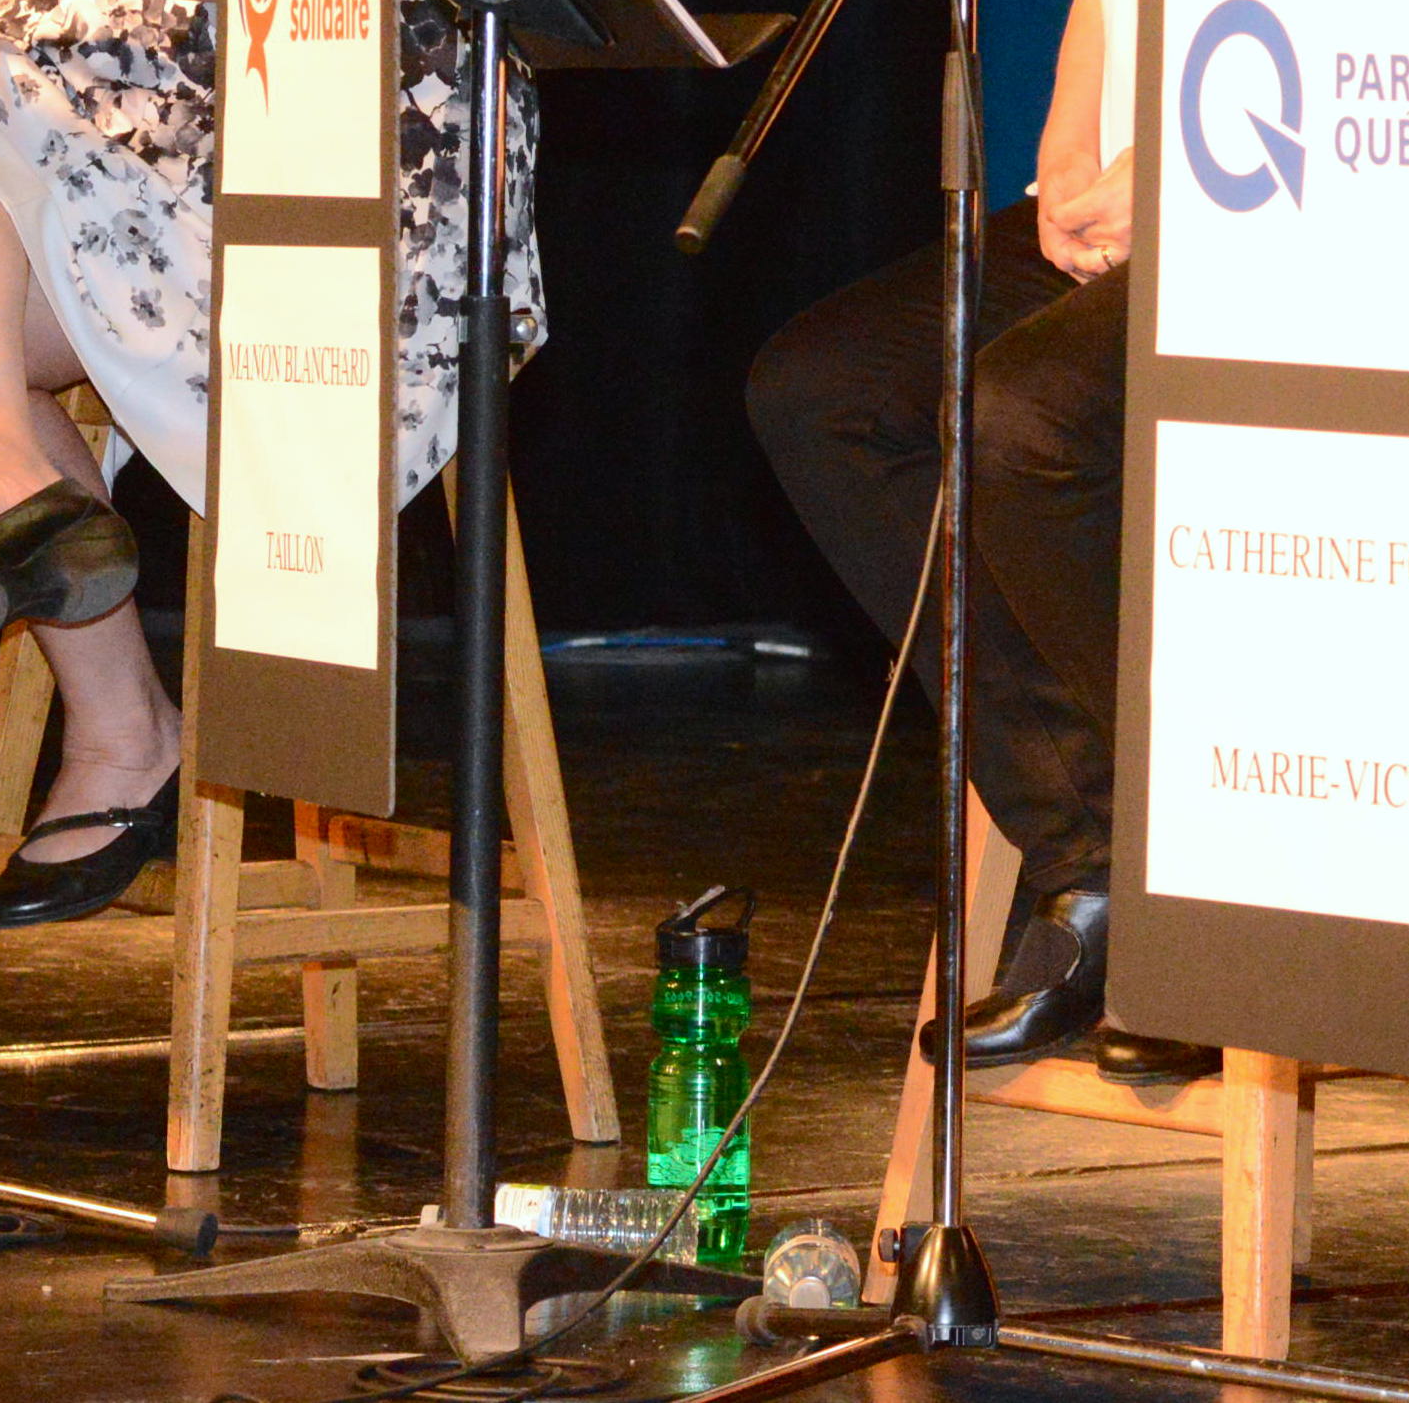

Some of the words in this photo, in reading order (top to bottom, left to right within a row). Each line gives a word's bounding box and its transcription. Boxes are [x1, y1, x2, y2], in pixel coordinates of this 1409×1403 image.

[229, 342, 282, 382] MANON
[283, 344, 370, 388] BLANCHARD
[265, 530, 324, 575] TAILLON
[1168, 524, 1376, 583] CATHERINE
